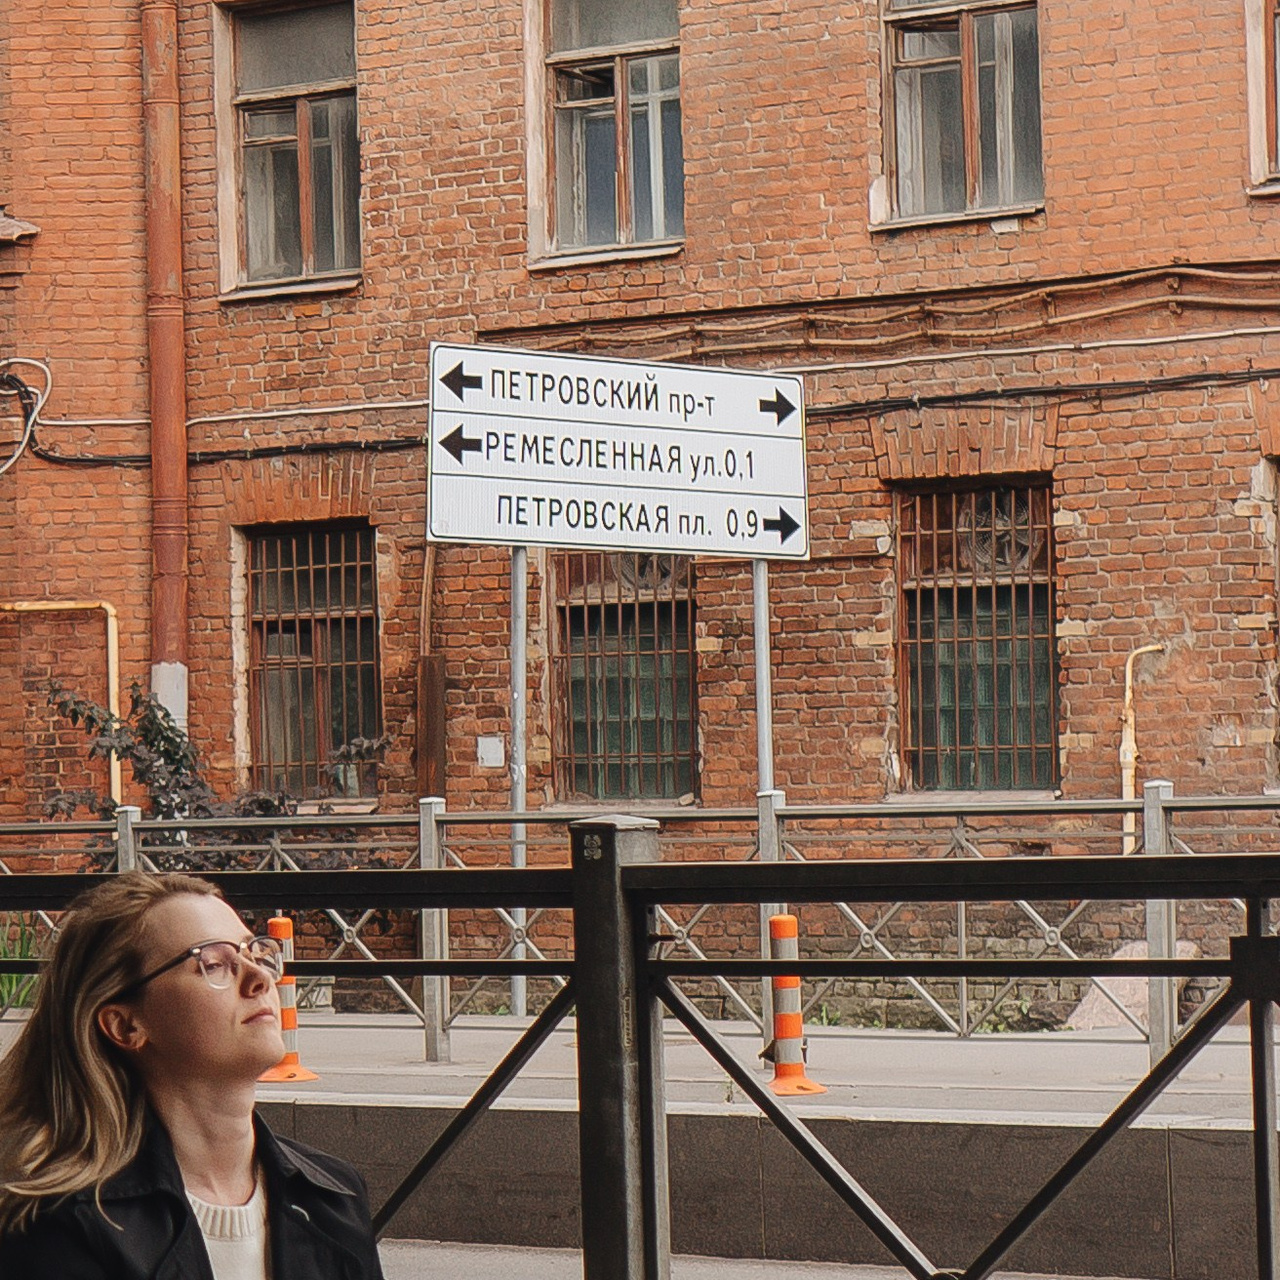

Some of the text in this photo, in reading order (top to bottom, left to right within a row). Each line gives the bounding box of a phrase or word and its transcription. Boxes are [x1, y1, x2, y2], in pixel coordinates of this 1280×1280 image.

[490, 369, 716, 422] ПЕТРОВСКИЙ пр-т
[486, 431, 682, 474] РЕМЕСЛЕННАЯ
[497, 495, 758, 541] ПЕТРОВСКАЯ пл. 0,9
